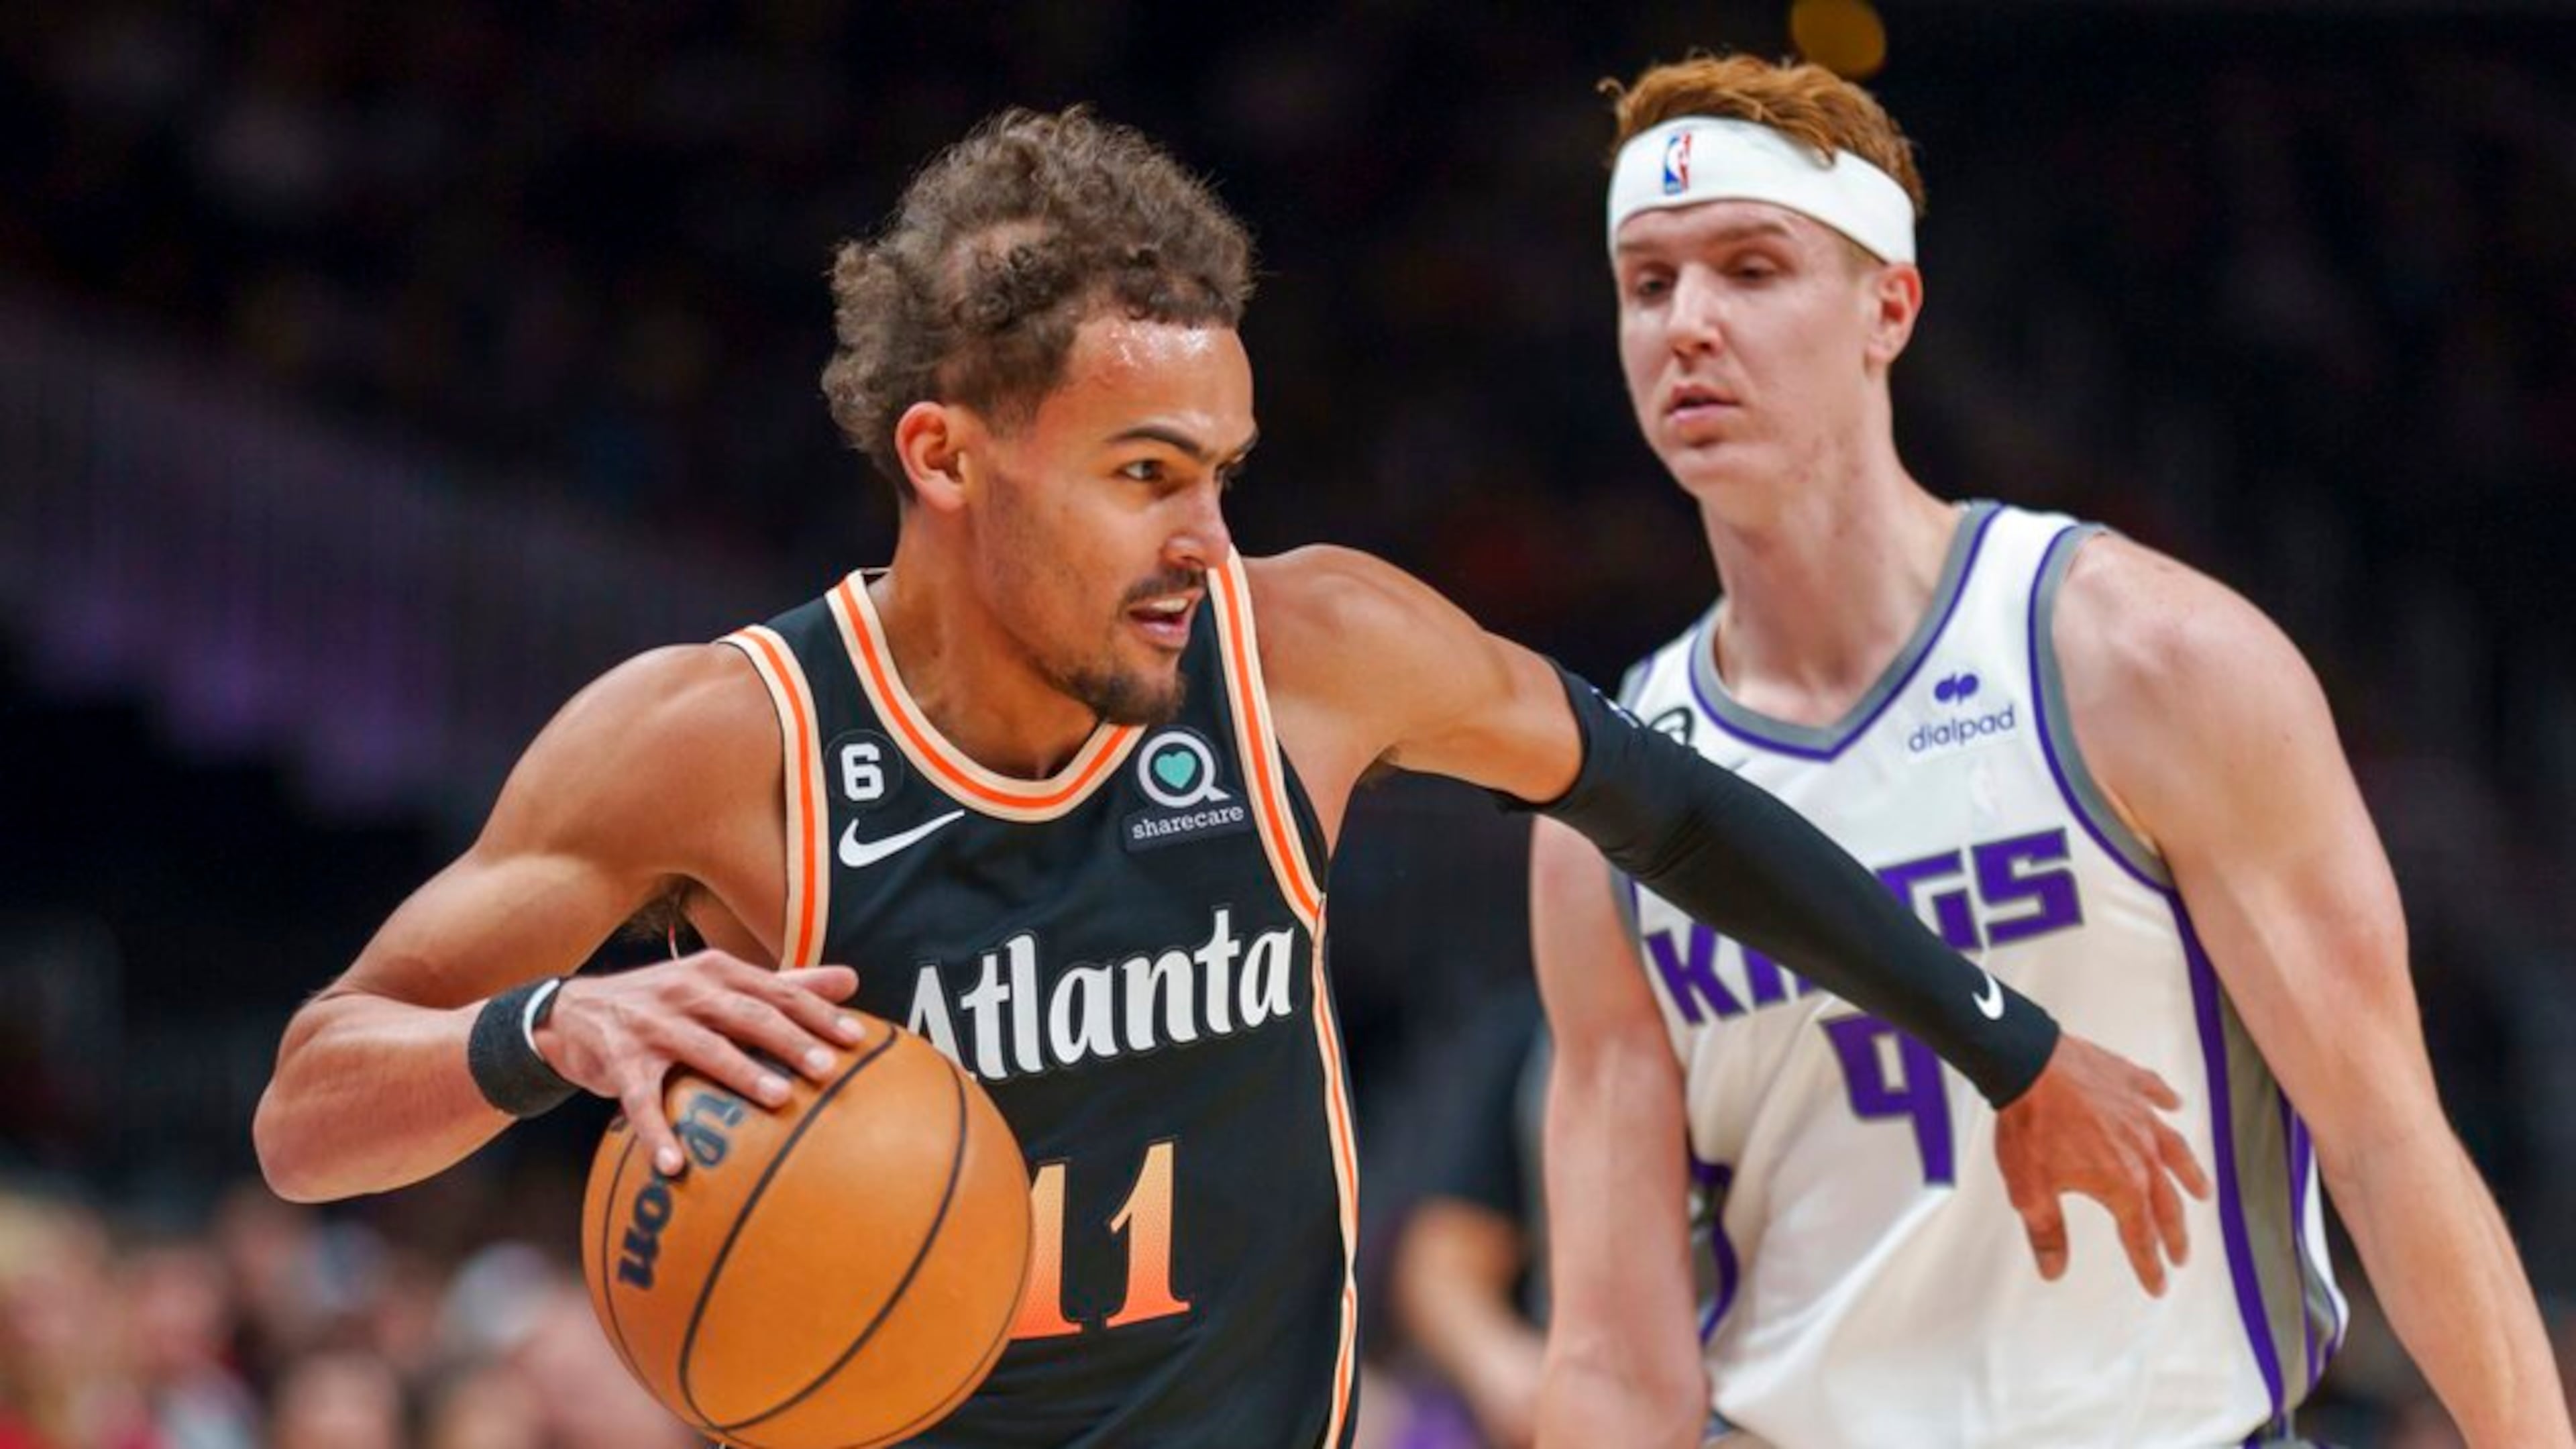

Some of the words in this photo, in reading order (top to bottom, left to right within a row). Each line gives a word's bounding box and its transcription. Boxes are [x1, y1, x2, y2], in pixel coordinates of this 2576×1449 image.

[841, 742, 884, 801] 6
[1909, 703, 2015, 752] dialpad
[1132, 806, 1244, 839] sharecare
[908, 909, 1294, 1080] Atlanta
[1644, 826, 2085, 1025] KIGS
[1818, 1010, 1955, 1186] 9
[618, 1092, 746, 1290] ilon
[1007, 1142, 1190, 1340] 11
